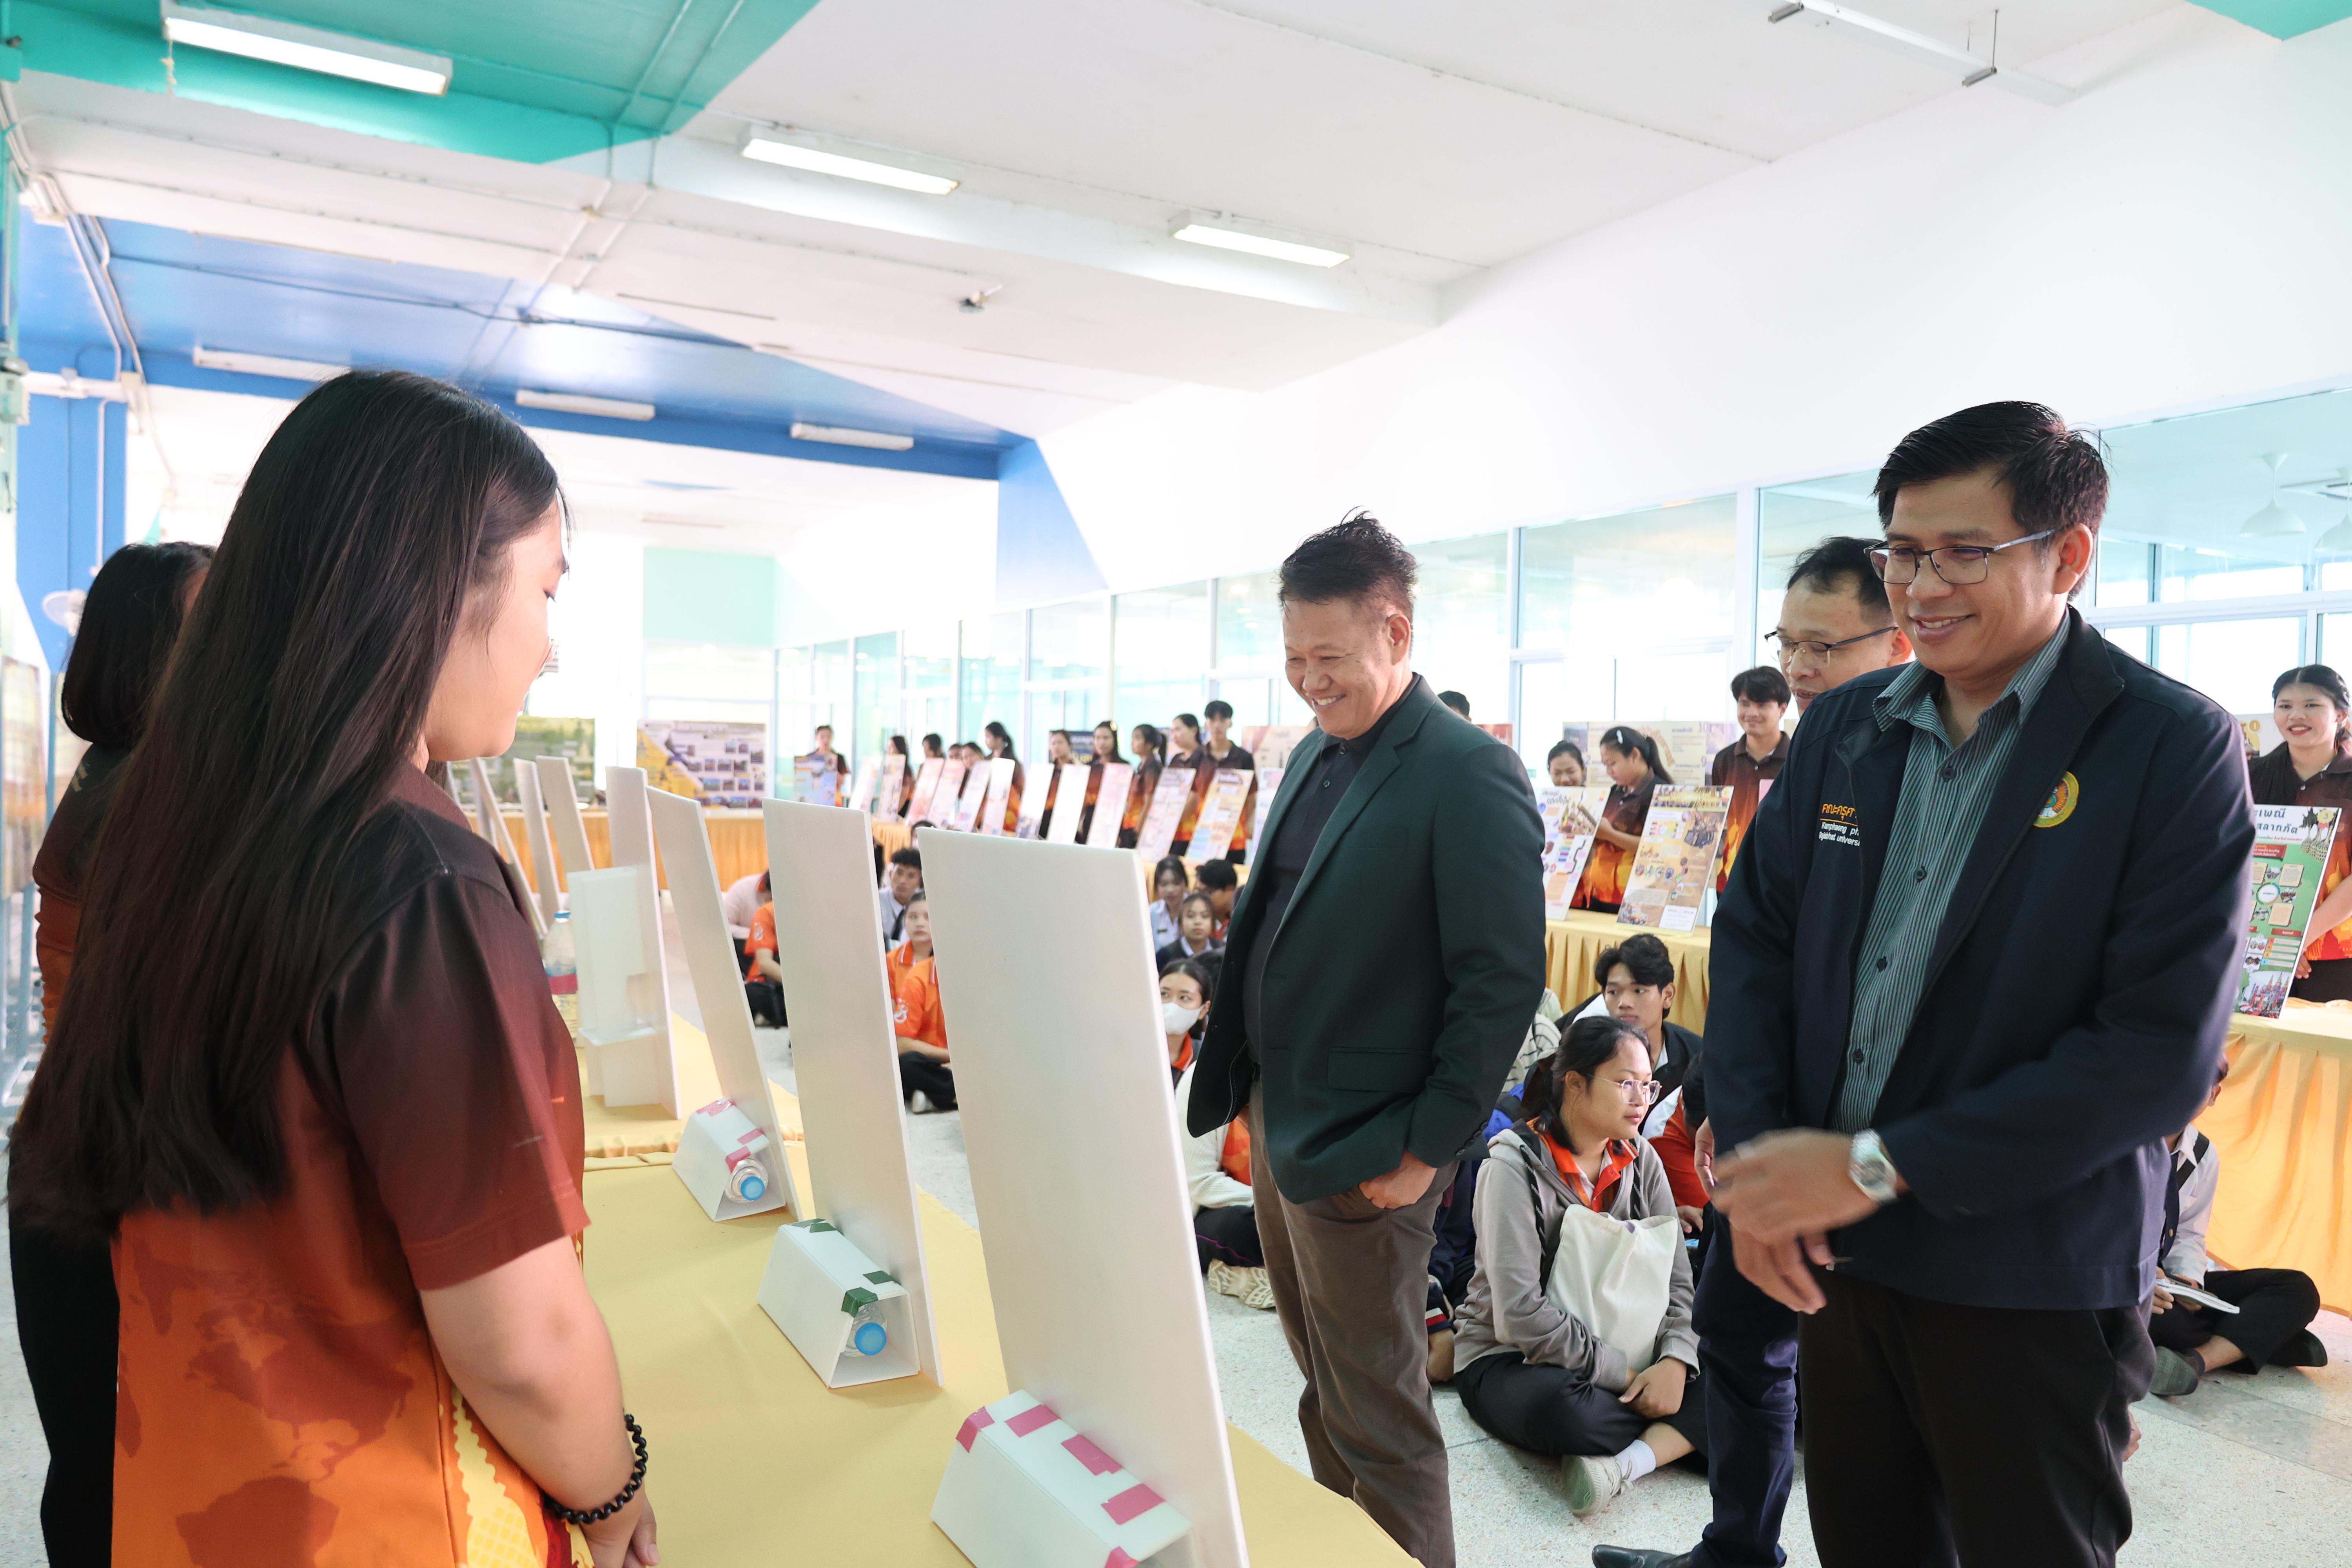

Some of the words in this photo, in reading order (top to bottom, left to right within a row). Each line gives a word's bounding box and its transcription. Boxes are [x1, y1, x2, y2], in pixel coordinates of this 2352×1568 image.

[1822, 803, 1857, 821] คณะครุศ
[1821, 821, 1847, 835] Kamphaeng
